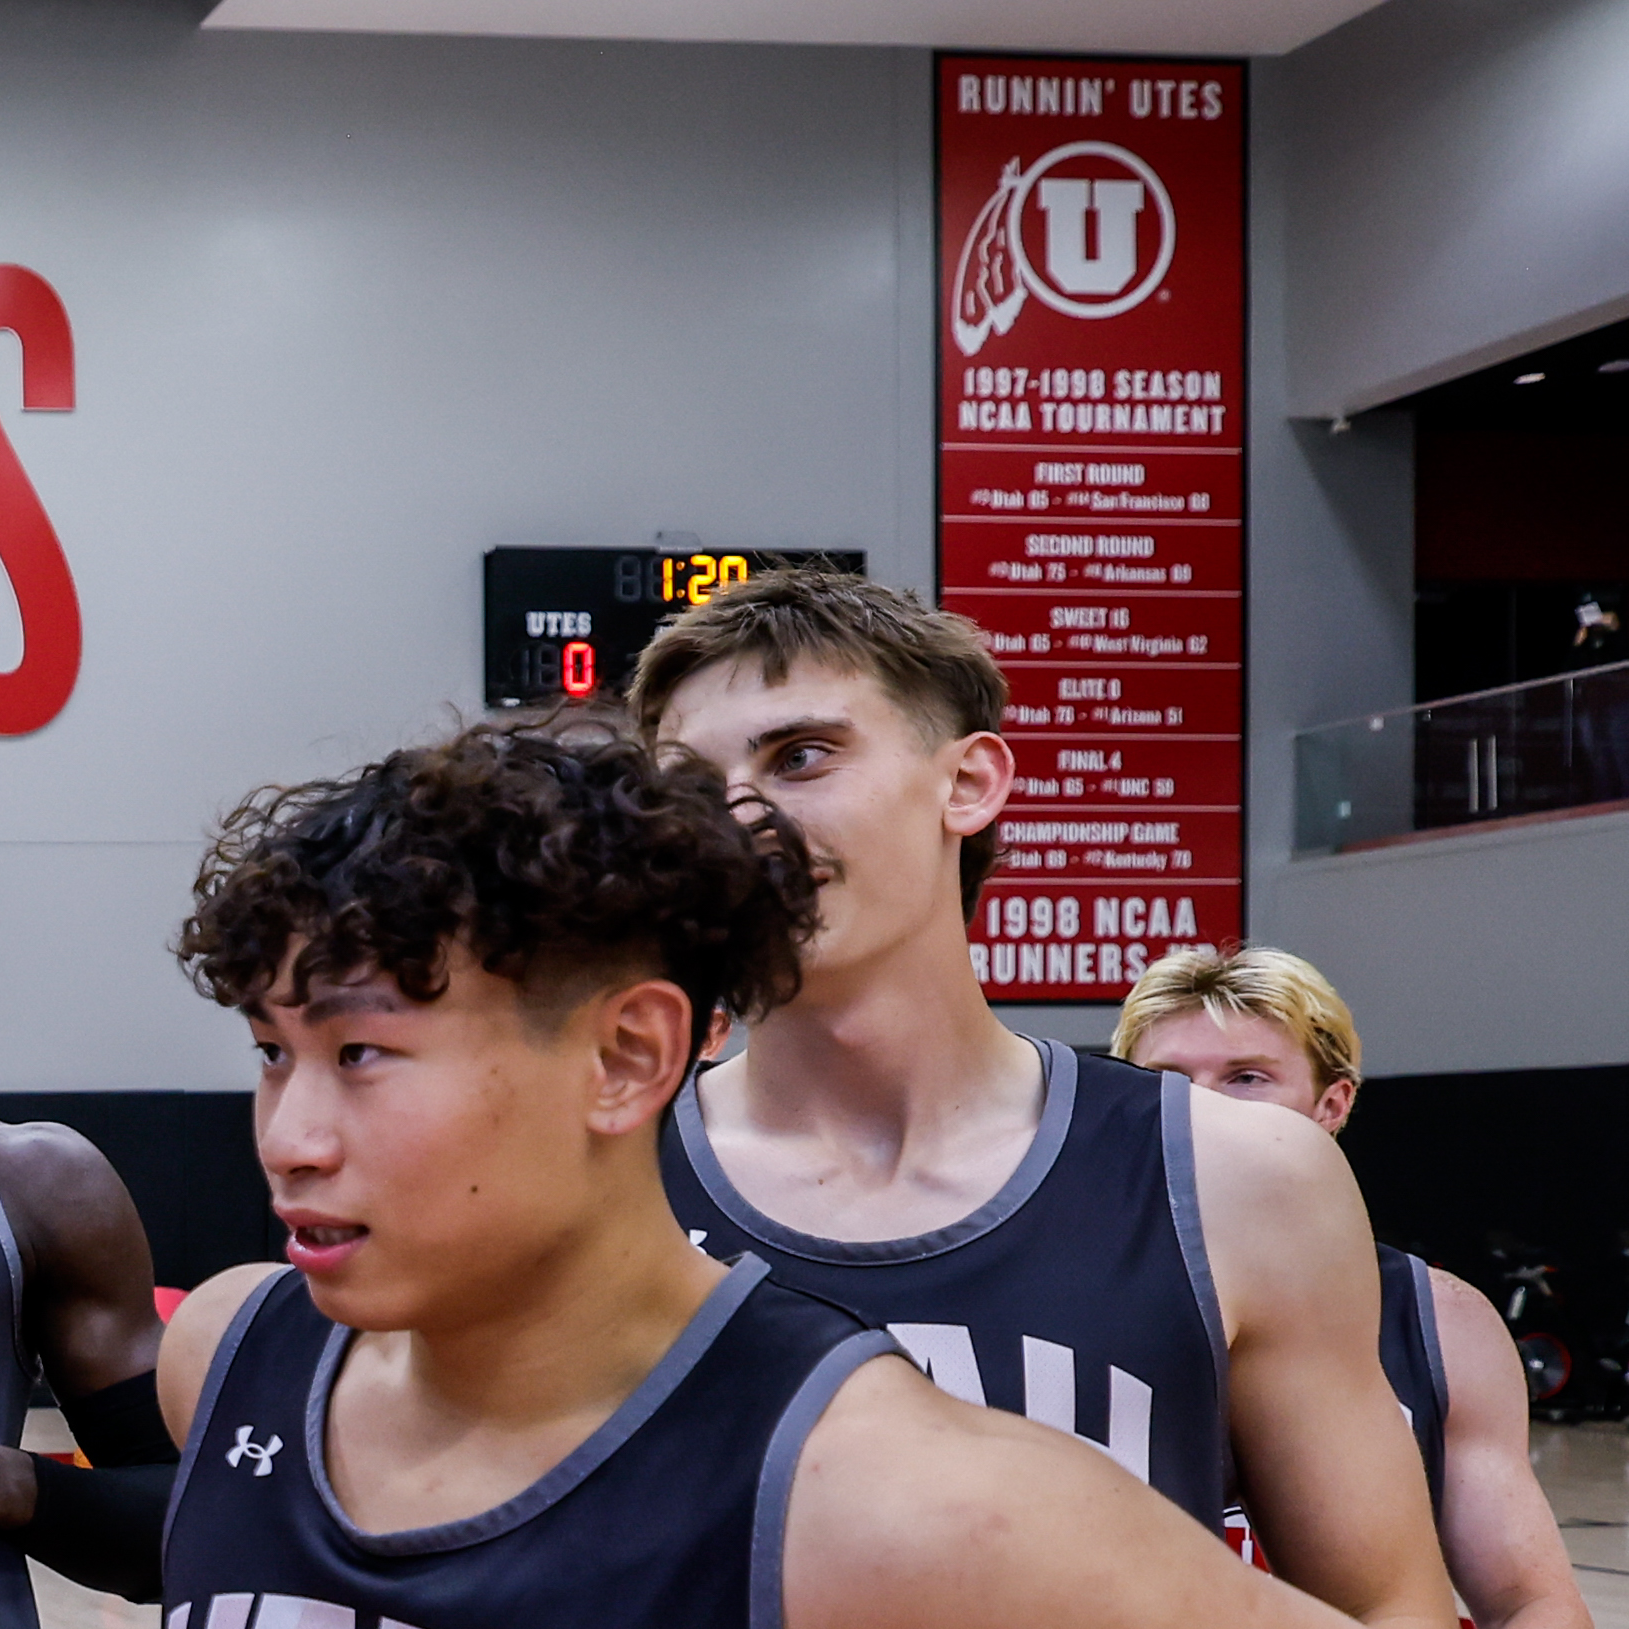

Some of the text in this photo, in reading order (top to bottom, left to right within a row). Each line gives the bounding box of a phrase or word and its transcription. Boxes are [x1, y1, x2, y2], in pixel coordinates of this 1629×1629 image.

[958, 74, 1223, 120] RUNNIN' UTES
[1038, 177, 1144, 294] U
[964, 367, 1222, 400] 1997-1998 SEASON
[958, 400, 1226, 434] NCAA TOURNAMENT
[1035, 462, 1145, 486] FIRST ROUND
[991, 489, 1024, 510] Utah
[1025, 533, 1154, 558] SECOND ROUND
[1008, 562, 1042, 581] Utah
[527, 611, 592, 637] UTES
[1049, 606, 1108, 629] SWEET
[993, 633, 1026, 653] Utah
[1092, 634, 1129, 653] West
[1129, 634, 1183, 658] Virginia
[563, 641, 595, 698] 0
[1058, 678, 1107, 700] ELITE
[1017, 705, 1050, 725] Utah
[1108, 706, 1162, 726] Arizona
[1057, 750, 1122, 772] FINAL 4
[1026, 778, 1059, 796] Utah
[1118, 778, 1149, 797] UNC
[1000, 821, 1180, 844] CHAMPIONSHIP GAME
[986, 896, 1197, 938] 1998 NCAA
